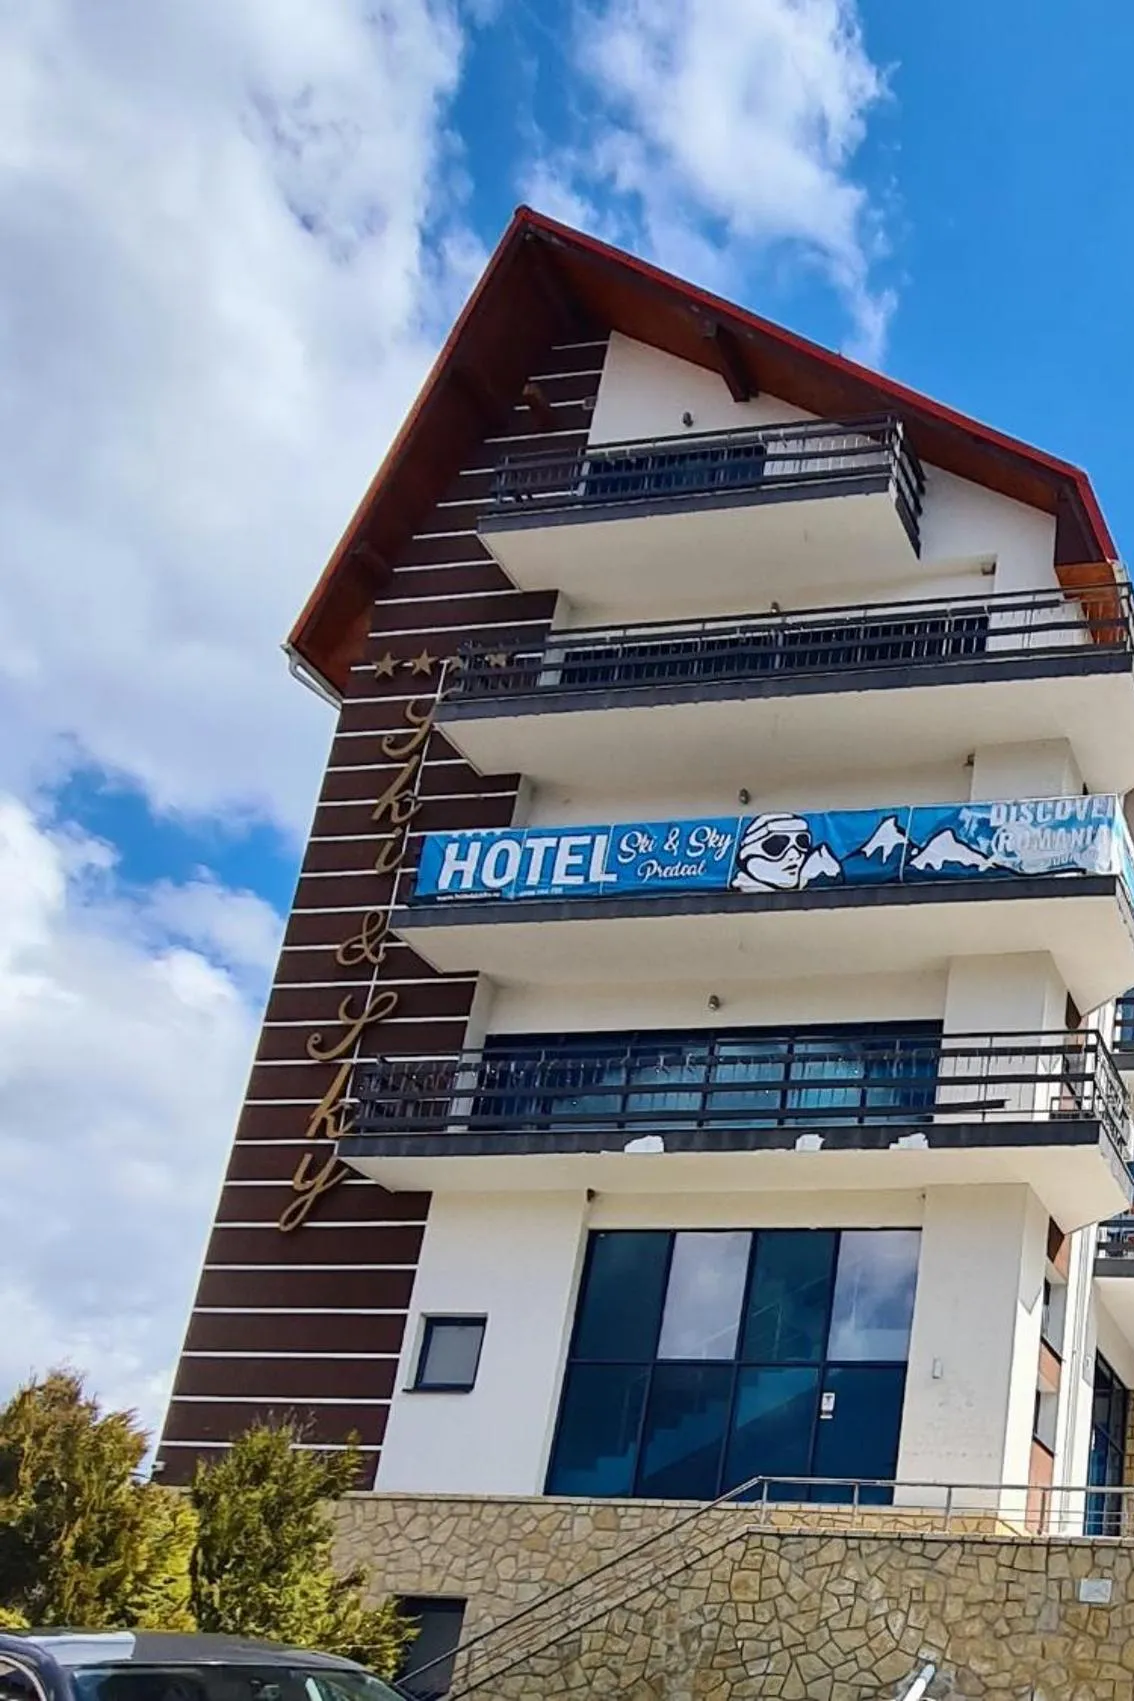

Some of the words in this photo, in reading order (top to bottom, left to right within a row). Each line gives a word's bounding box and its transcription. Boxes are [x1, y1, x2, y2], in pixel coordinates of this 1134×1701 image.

[438, 834, 617, 890] HOTEL
[617, 831, 657, 863] Ski
[664, 827, 680, 856] &
[686, 826, 732, 861] Sky
[637, 859, 706, 883] Predeal
[336, 908, 387, 965] &
[279, 992, 398, 1232] Sky
